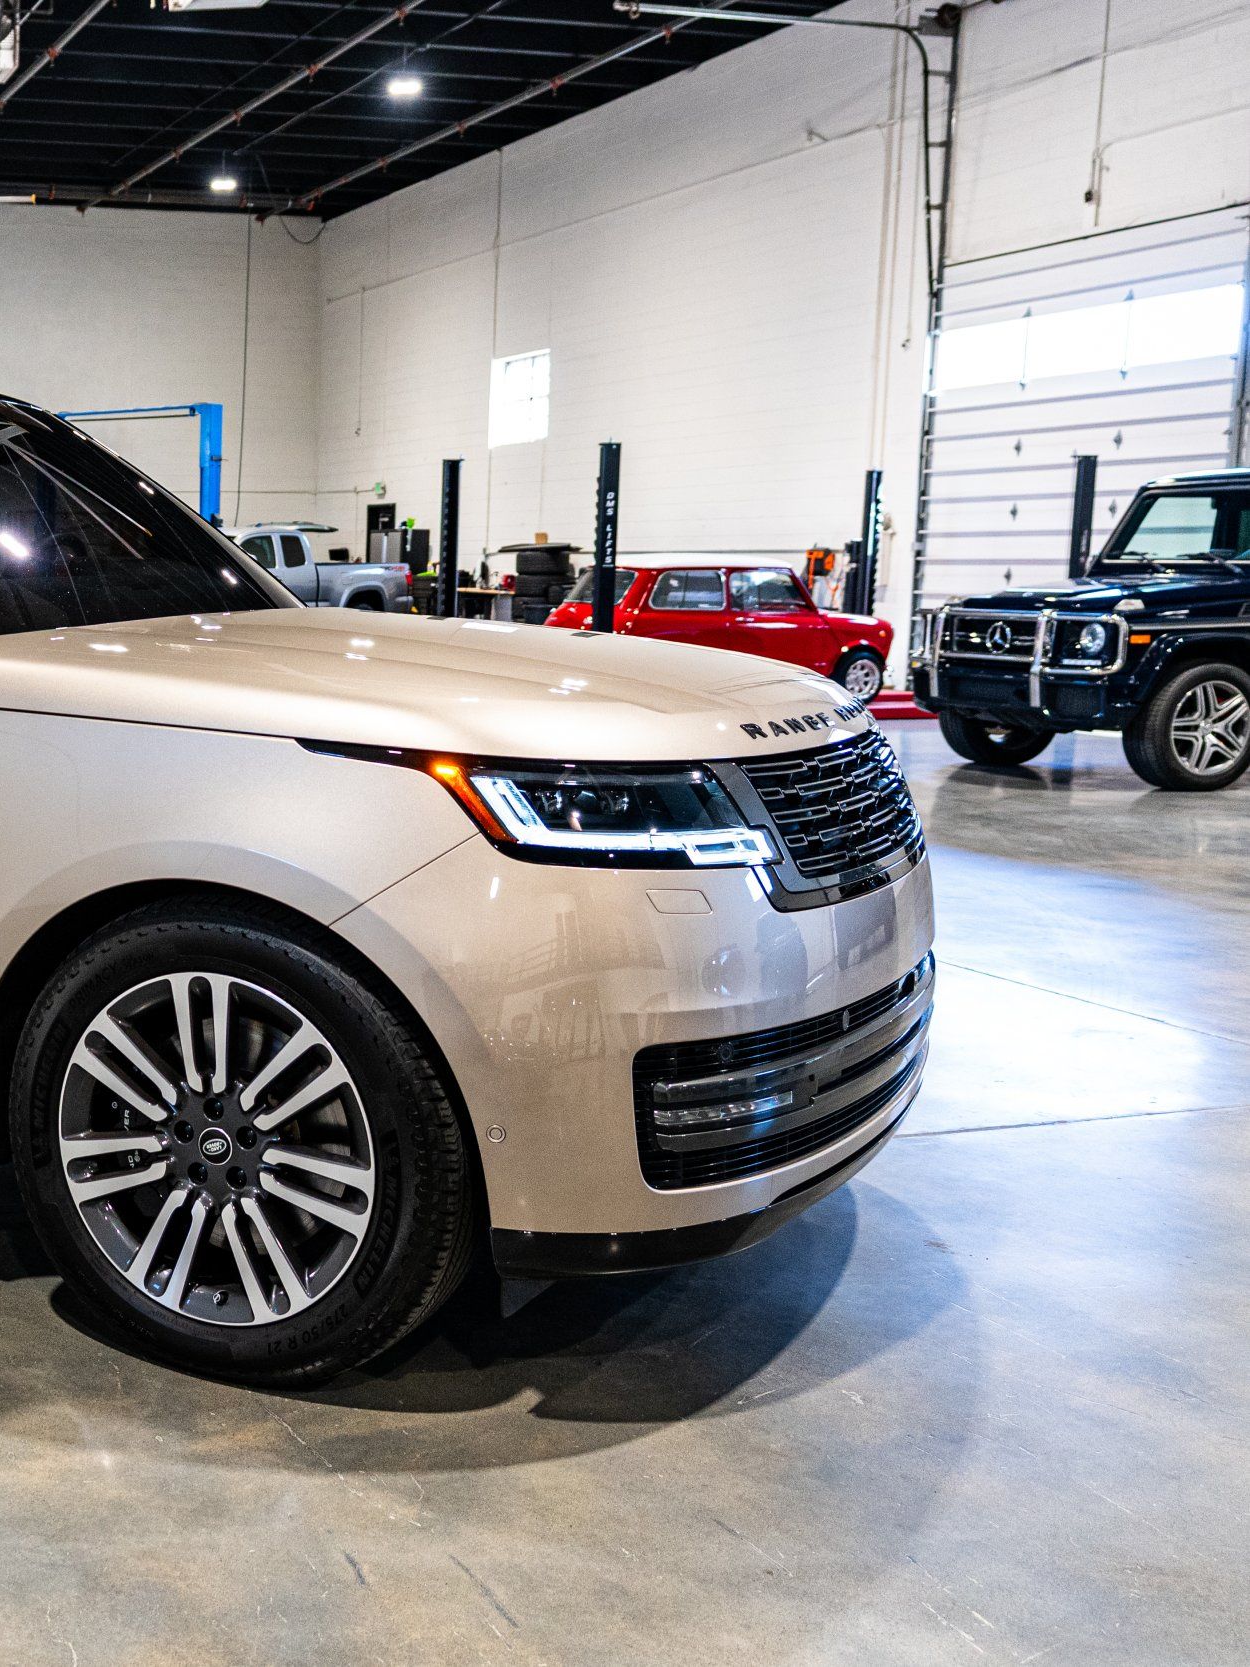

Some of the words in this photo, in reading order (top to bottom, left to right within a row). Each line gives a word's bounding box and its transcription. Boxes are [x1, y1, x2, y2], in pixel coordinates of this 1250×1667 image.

[605, 491, 615, 516] DMS
[604, 524, 613, 563] LIFTS
[739, 711, 831, 740] RANGE
[69, 961, 117, 1012] PRIMACY
[32, 1022, 67, 1129] MICHELIN
[356, 1175, 397, 1290] MICHELIN
[287, 1335, 299, 1351] R
[302, 1303, 349, 1345] 275/50
[266, 1341, 282, 1356] 21
